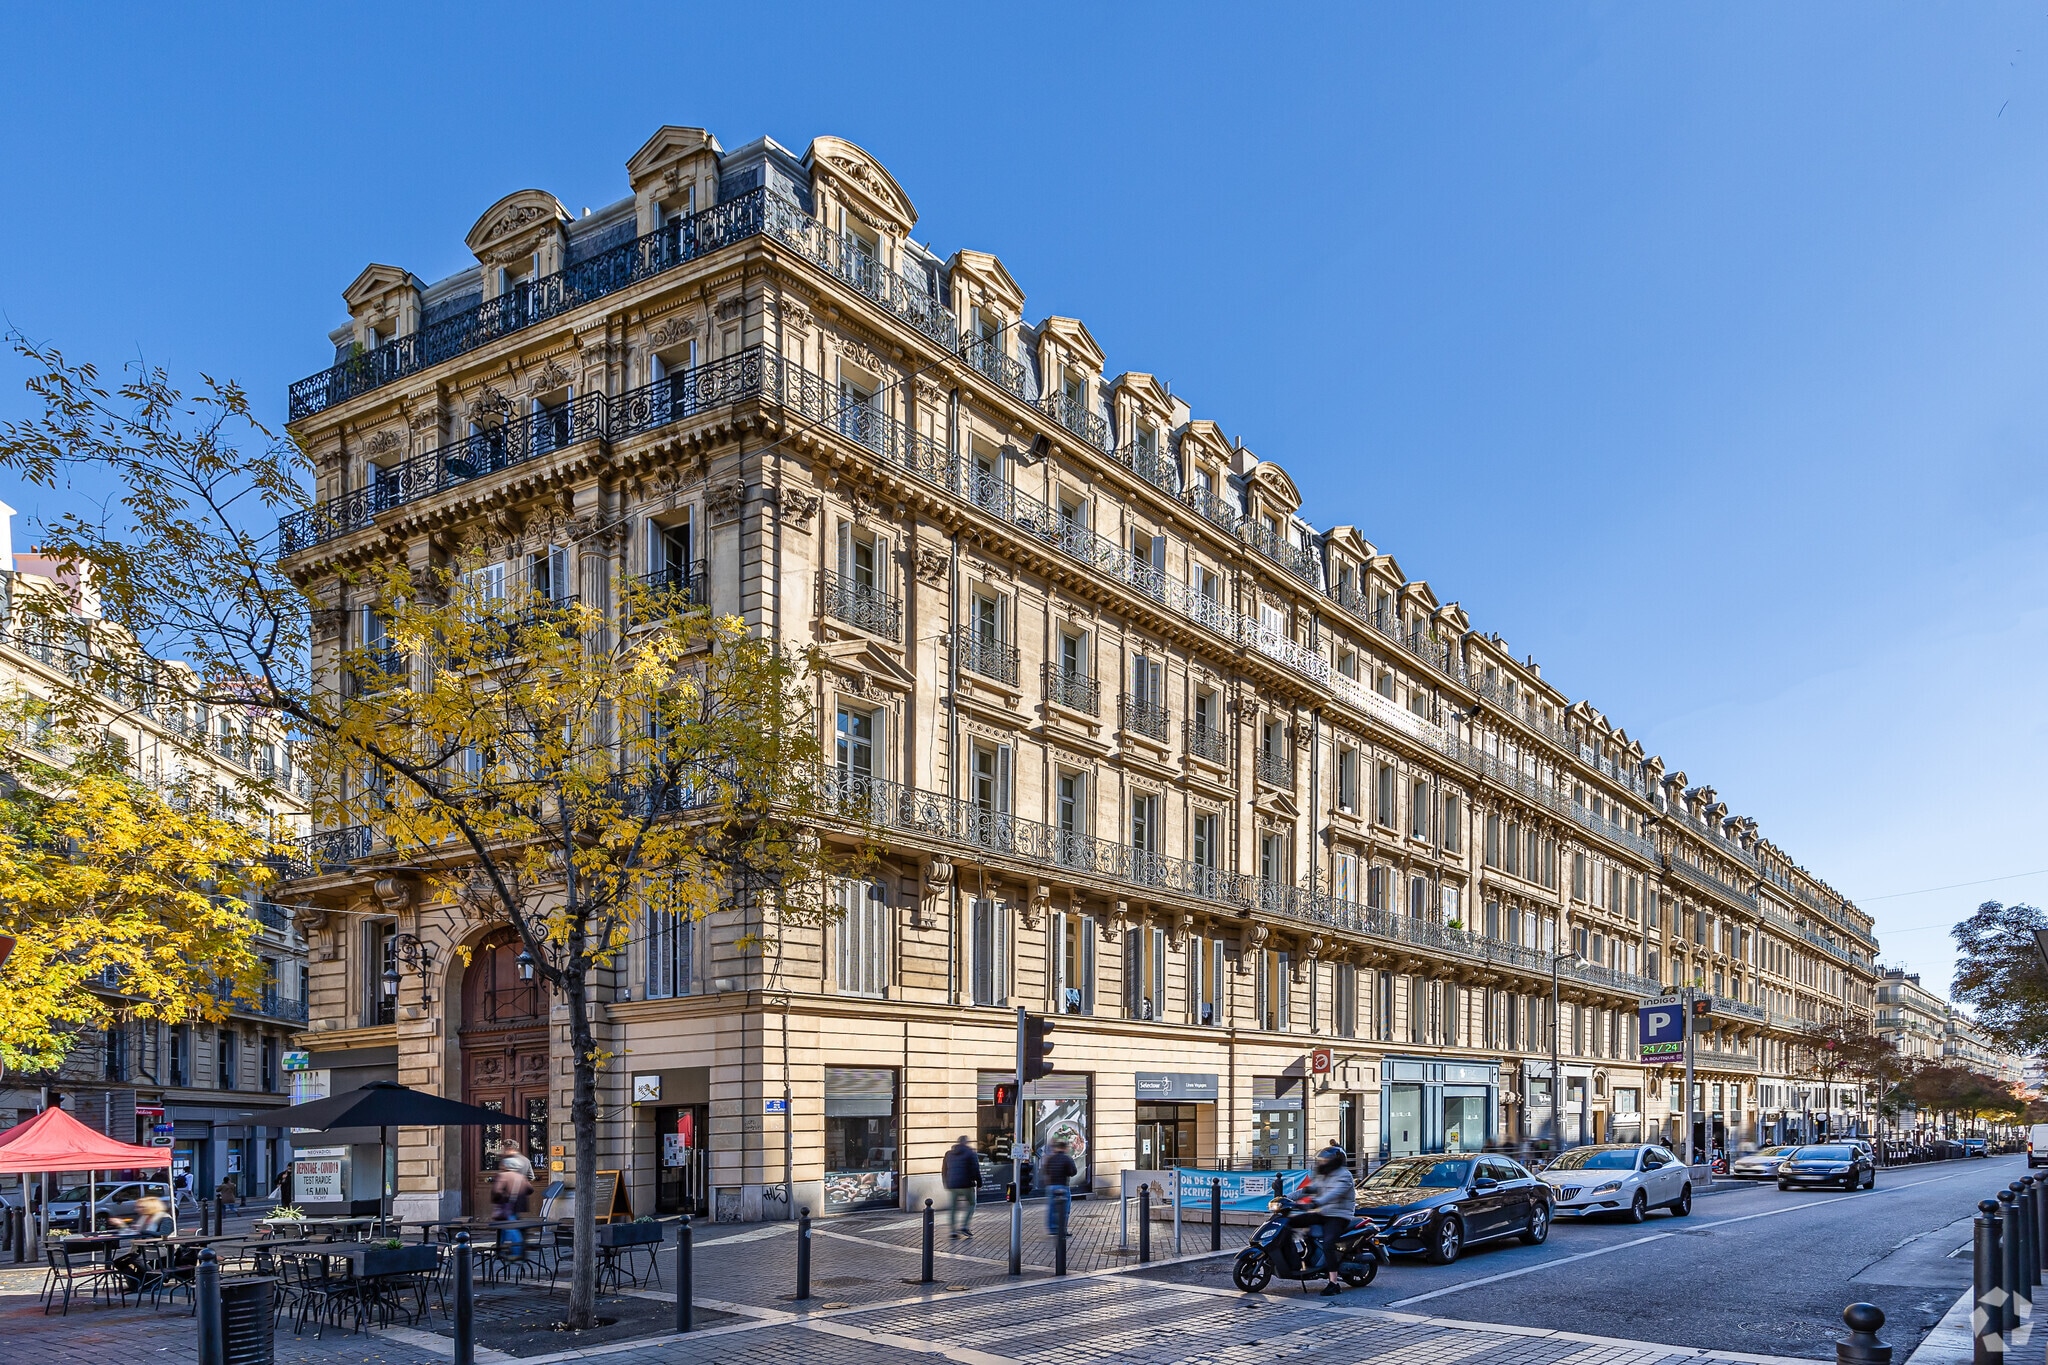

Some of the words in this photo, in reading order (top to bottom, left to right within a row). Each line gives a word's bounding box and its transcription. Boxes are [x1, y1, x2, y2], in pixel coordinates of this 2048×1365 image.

[1643, 996, 1676, 1006] INDIGO
[1648, 1012, 1671, 1037] P
[1643, 1045, 1655, 1054] 24
[1665, 1043, 1678, 1052] 24
[1140, 1081, 1161, 1089] Selectour
[296, 1162, 318, 1175] DEPISTAGE
[303, 1176, 314, 1185] TEST
[315, 1175, 332, 1185] RAPIDE
[1195, 1176, 1204, 1186] DE
[305, 1187, 314, 1196] 15
[315, 1187, 329, 1195] MIN
[1220, 1189, 1239, 1199] OUS
